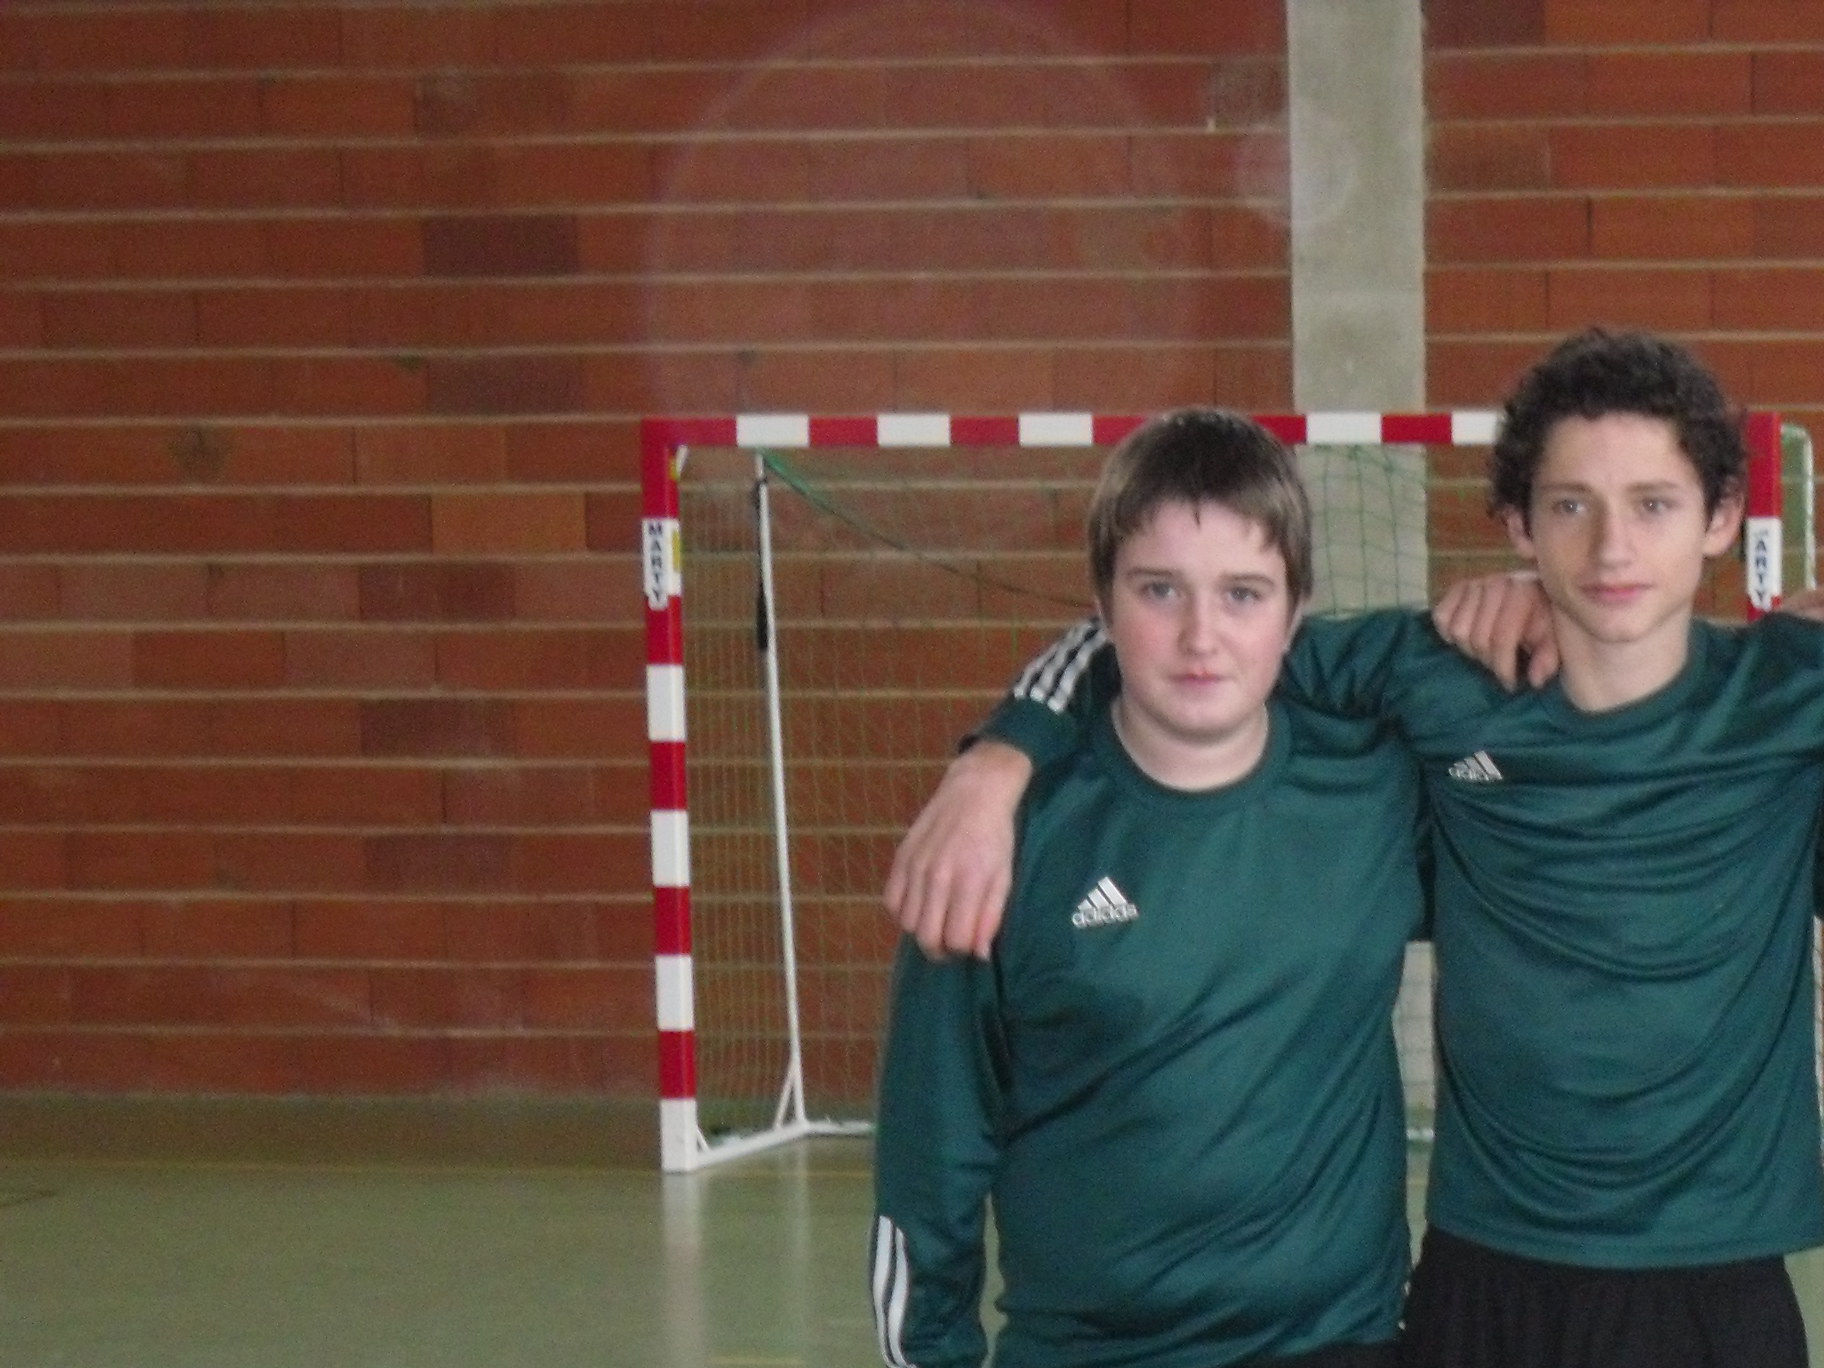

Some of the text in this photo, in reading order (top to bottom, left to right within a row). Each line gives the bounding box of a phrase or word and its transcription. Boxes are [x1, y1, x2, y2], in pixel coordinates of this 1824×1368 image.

[648, 521, 663, 602] MARTY
[1447, 766, 1503, 783] adid
[1072, 902, 1138, 928] adidas
